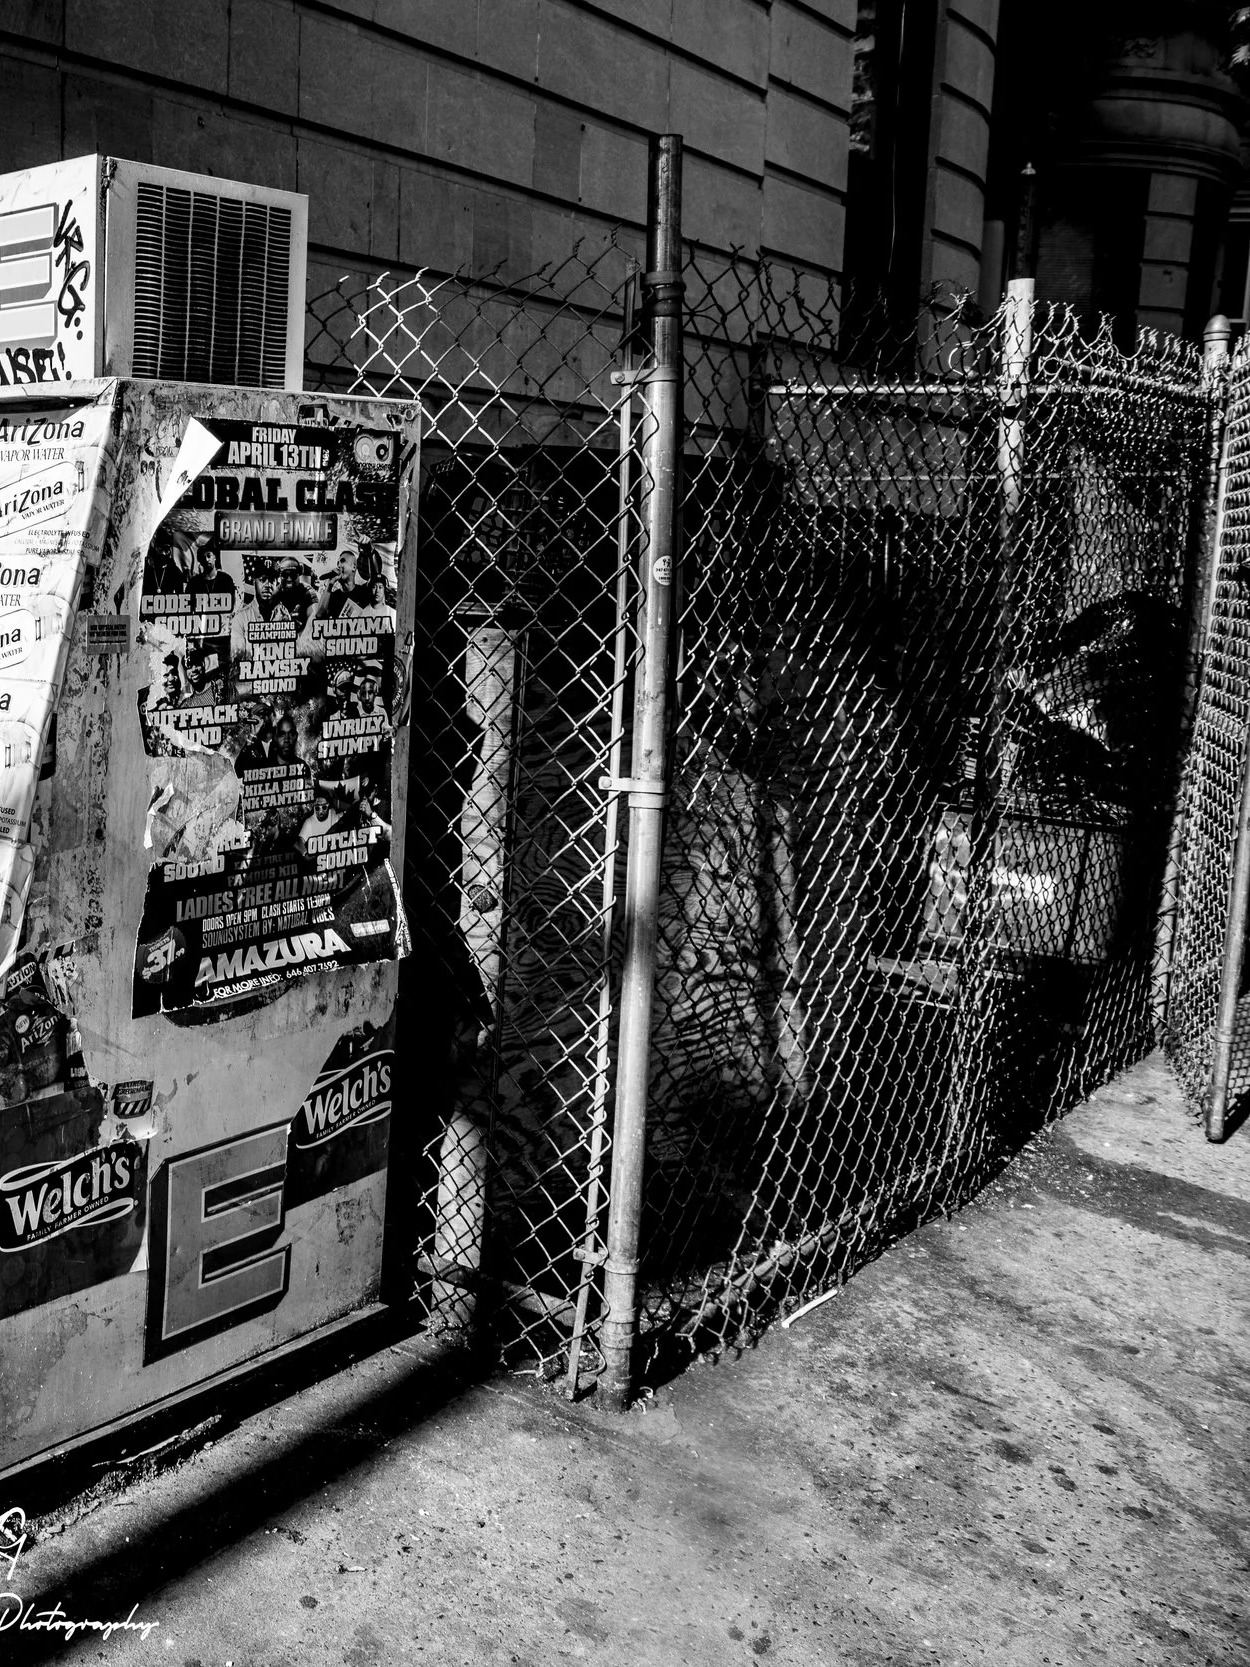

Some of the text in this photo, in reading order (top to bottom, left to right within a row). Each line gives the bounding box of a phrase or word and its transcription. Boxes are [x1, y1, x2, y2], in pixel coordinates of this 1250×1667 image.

[252, 427, 297, 444] FRIDAY
[0, 448, 65, 462] VAPOR WATER
[227, 441, 322, 469] APRIL 13TH
[220, 518, 333, 544] GRAND FINALE
[141, 592, 232, 614] CODE RED
[155, 614, 220, 636] SOUND
[249, 622, 295, 632] DEFENDING
[249, 630, 297, 641] CHAMPIONS
[312, 617, 393, 638] FUJIYAMA
[253, 642, 295, 661] KING
[326, 637, 378, 657] SOUND
[239, 658, 311, 680] RAMSEY
[253, 678, 297, 694] SOUND
[322, 716, 384, 739] UNRULY
[318, 735, 382, 760] STUMPY
[244, 763, 306, 782] HOSTED BY:
[245, 782, 280, 798] KILLA
[282, 778, 304, 792] BOO
[263, 789, 314, 808] PANTHER
[307, 826, 382, 854] OUTCAST
[164, 855, 225, 883] SOUND
[317, 847, 368, 871] SOUND
[176, 869, 347, 923] LADIES FREE ALL NIGHT
[202, 915, 224, 933] DOORS
[226, 912, 242, 928] OPEN
[243, 908, 258, 924] 9PM
[261, 903, 281, 919] CLASH
[282, 899, 305, 915] STARTS
[202, 906, 335, 949] SOUNDSYSTEM BY: NATURAL VIBES
[194, 928, 352, 988] AMAZURA
[7, 962, 37, 989] AUTION
[213, 983, 234, 998] FOR
[232, 976, 260, 993] MORE
[303, 1061, 391, 1133] Welch's
[316, 1101, 376, 1139] FAMILY FARMER OWNED
[5, 1150, 130, 1235] Welch's
[26, 1196, 109, 1241] FAMILY FARMER OWNED
[152, 1120, 290, 1360] E
